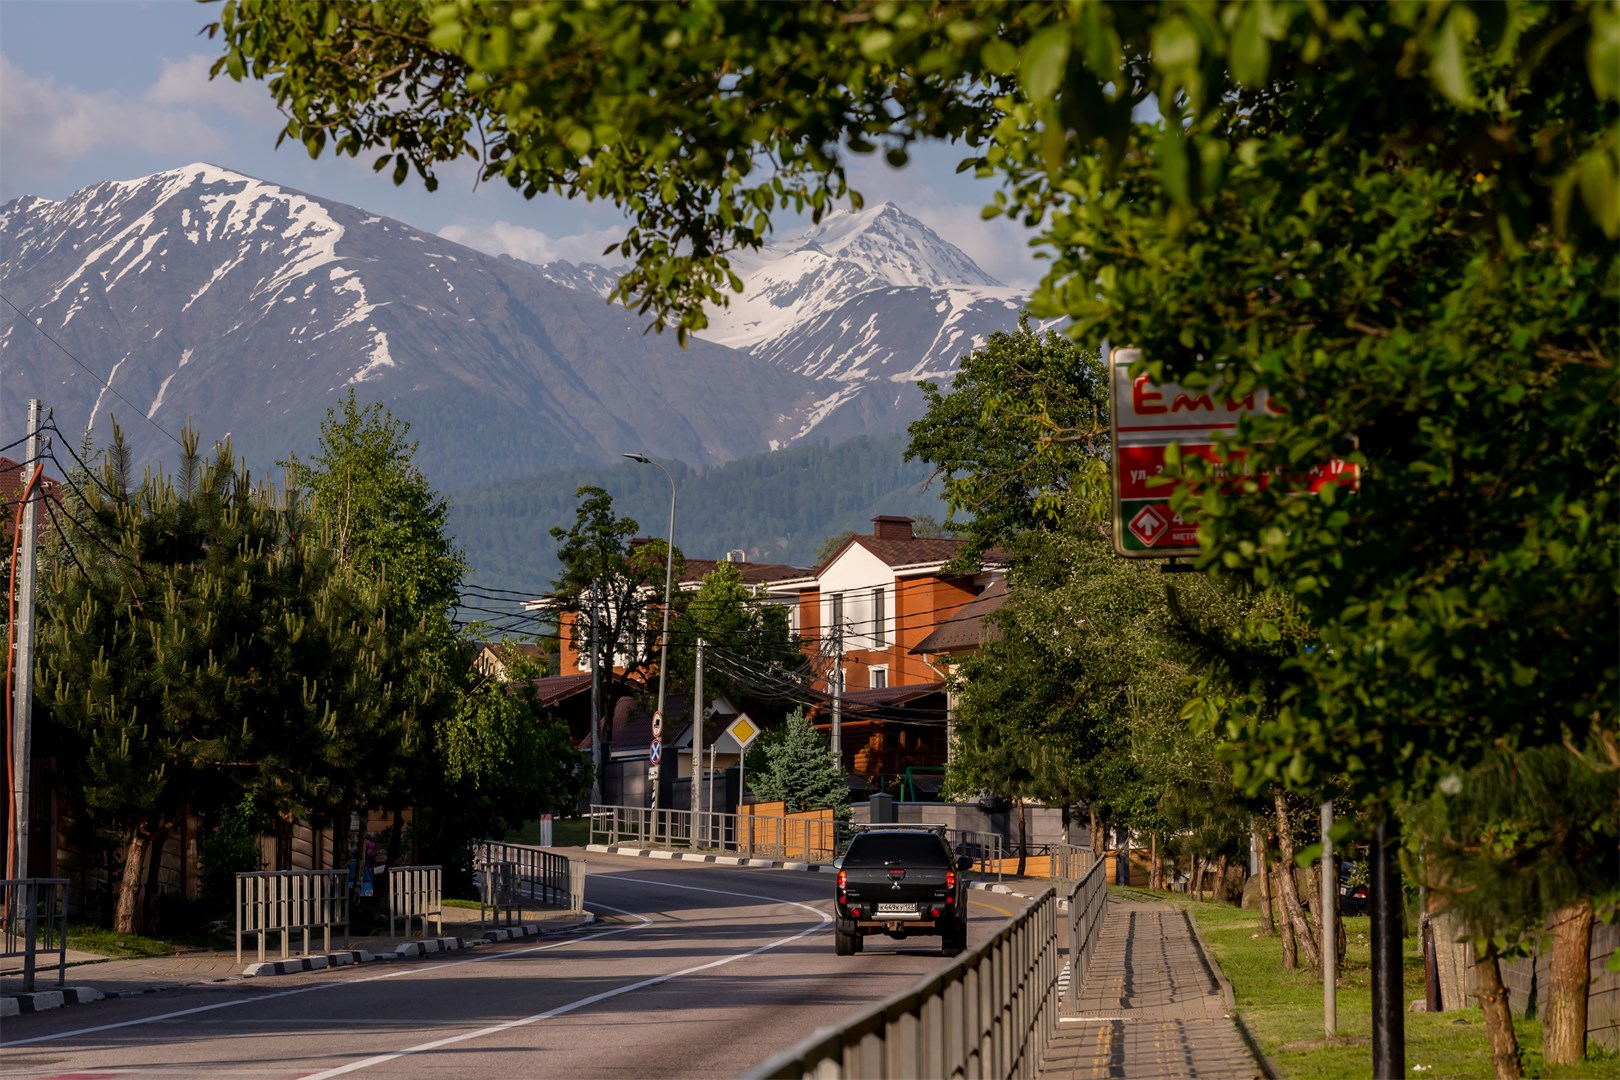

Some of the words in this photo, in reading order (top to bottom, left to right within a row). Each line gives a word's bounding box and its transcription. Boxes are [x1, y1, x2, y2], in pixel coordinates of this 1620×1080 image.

[1130, 468, 1151, 485] ул.
[1330, 459, 1345, 474] 17
[1172, 532, 1197, 541] МЕТР
